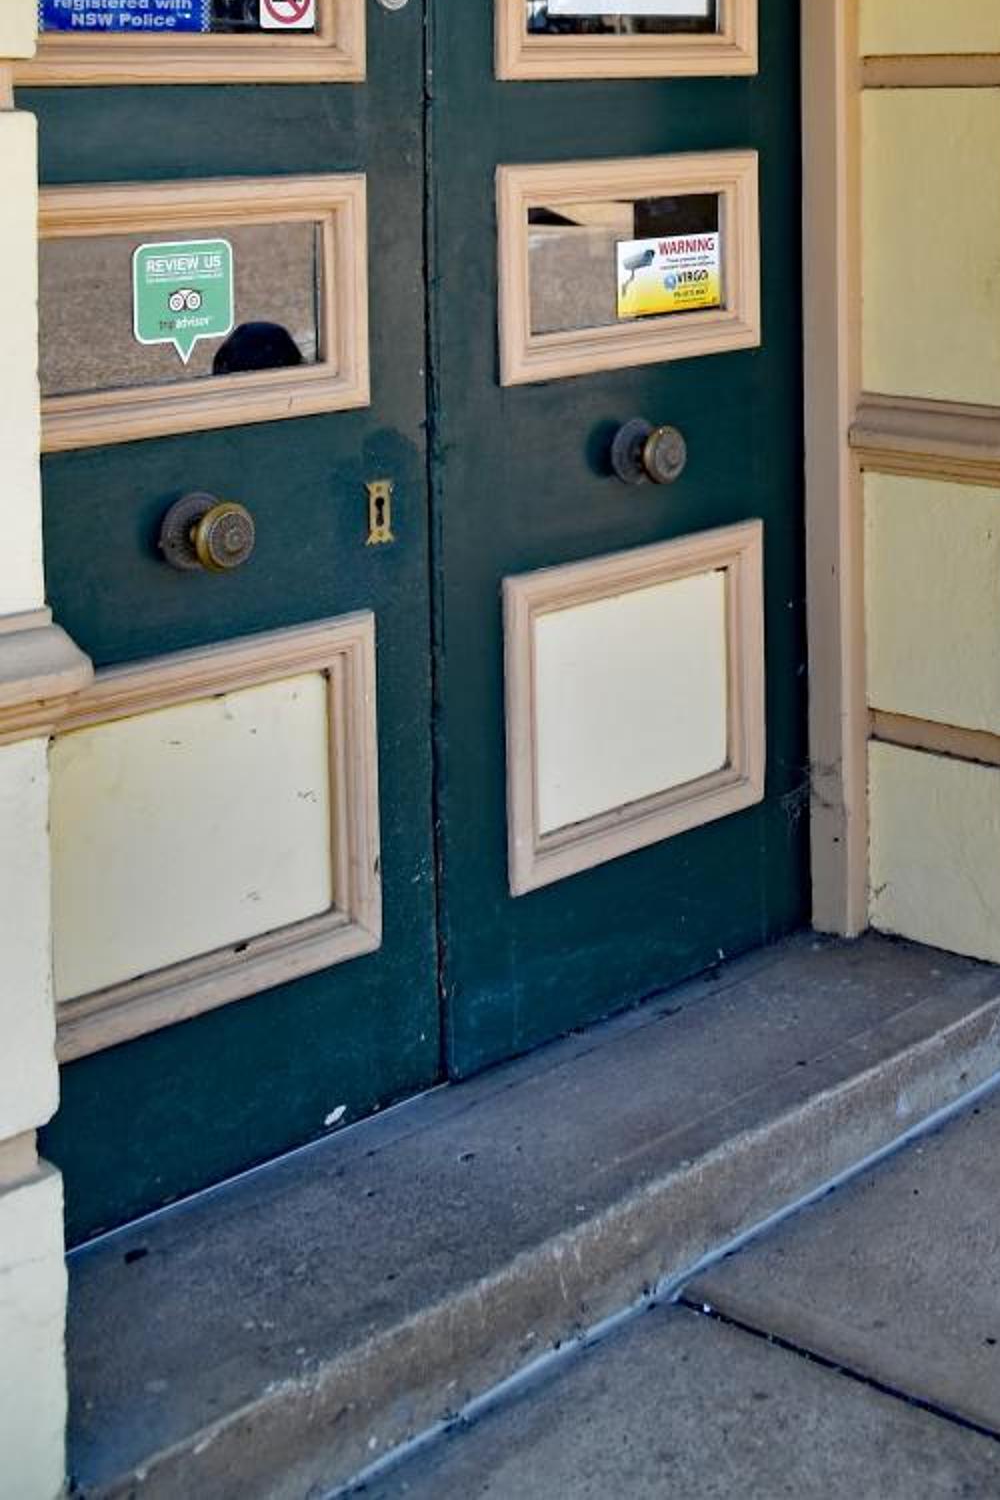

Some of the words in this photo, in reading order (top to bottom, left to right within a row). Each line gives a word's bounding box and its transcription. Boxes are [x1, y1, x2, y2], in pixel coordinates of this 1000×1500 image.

[72, 13, 113, 27] NSW
[119, 13, 177, 27] Police
[659, 237, 715, 256] WARNING
[146, 256, 199, 273] REVIEW
[203, 255, 222, 269] US
